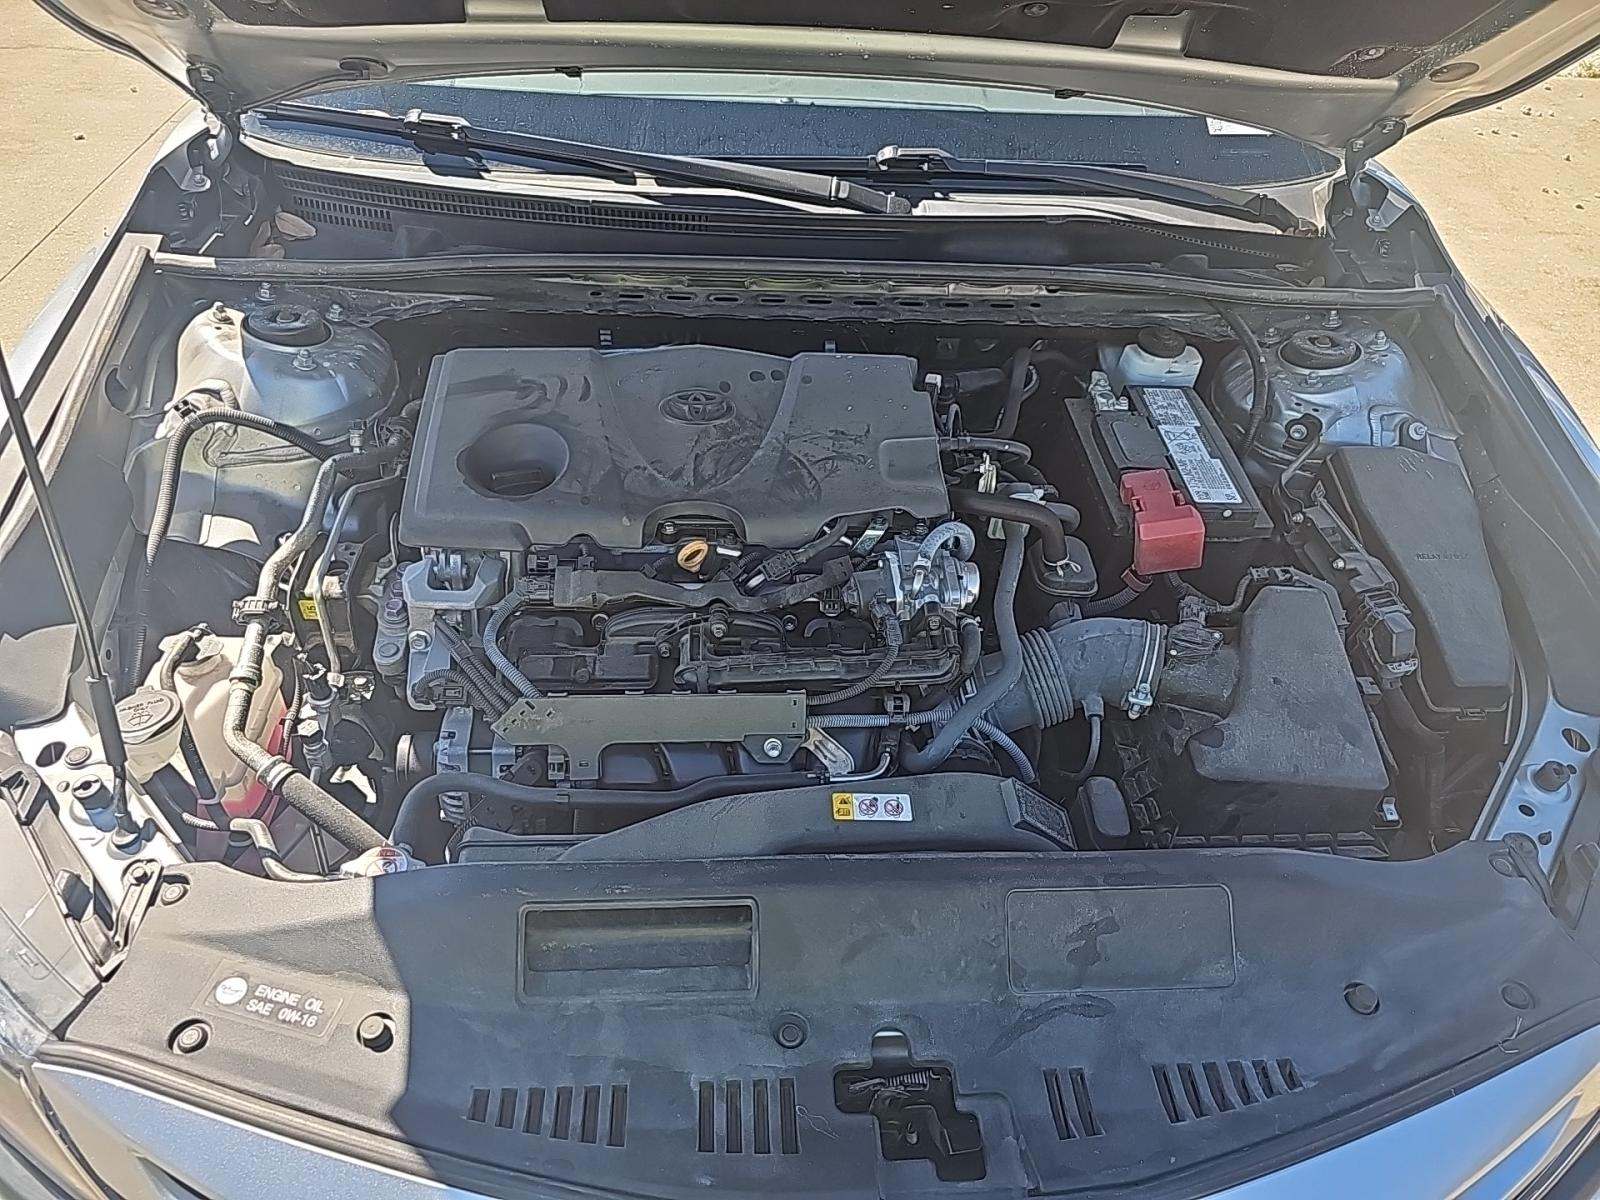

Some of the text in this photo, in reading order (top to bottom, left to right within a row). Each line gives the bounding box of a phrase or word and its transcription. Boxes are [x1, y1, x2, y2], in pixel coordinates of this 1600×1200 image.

[246, 998, 318, 1028] SAE 0W-16
[254, 984, 302, 1007] ENGINE
[304, 998, 324, 1014] OIL
